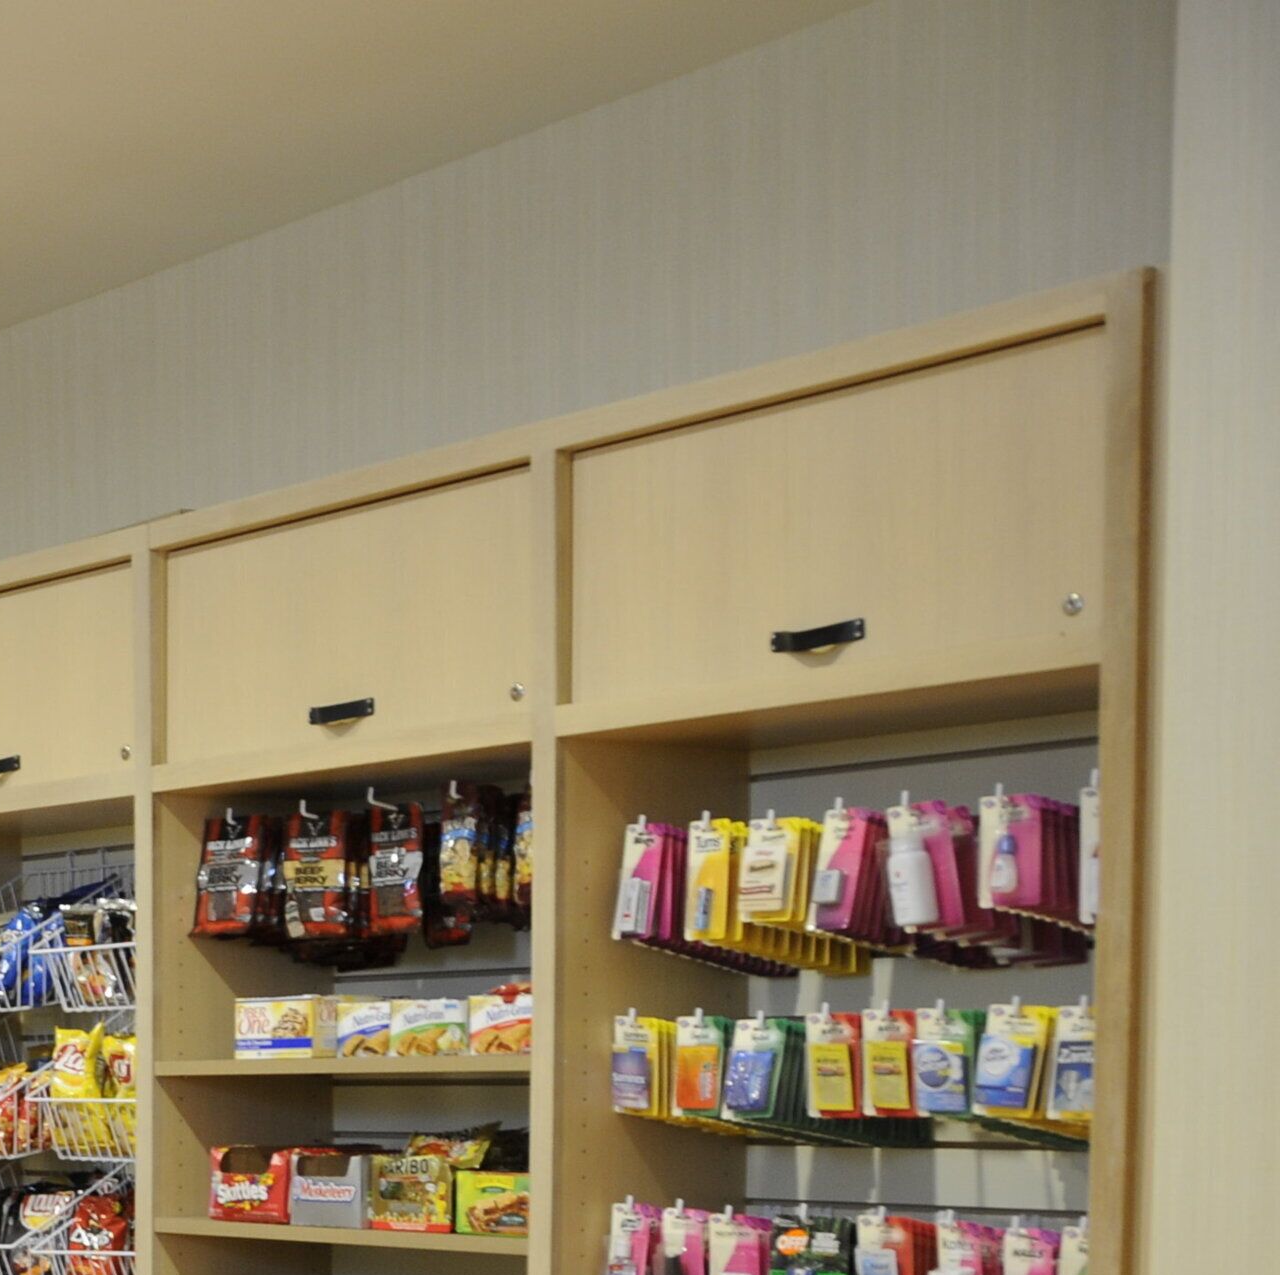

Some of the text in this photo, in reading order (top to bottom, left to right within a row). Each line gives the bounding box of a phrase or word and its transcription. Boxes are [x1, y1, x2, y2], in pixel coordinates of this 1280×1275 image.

[209, 866, 238, 876] BEEF
[295, 866, 325, 875] BEEF
[208, 873, 243, 885] JERKY
[294, 875, 328, 885] JERKY
[217, 1180, 269, 1205] Skittles
